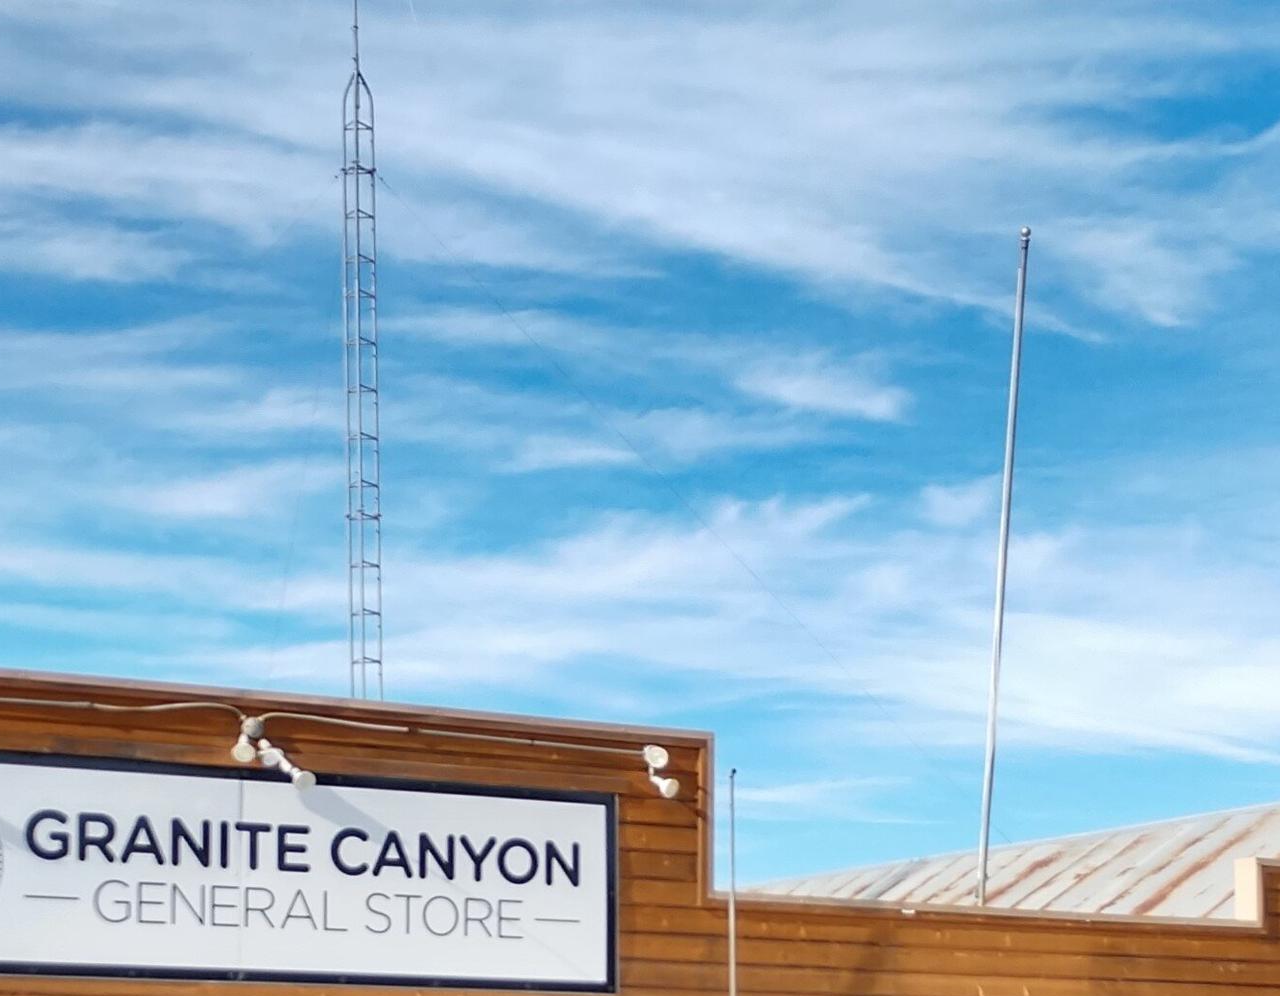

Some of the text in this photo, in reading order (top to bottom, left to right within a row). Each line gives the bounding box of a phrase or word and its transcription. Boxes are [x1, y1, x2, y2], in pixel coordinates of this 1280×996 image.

[24, 808, 582, 888] GRANITE CANYON
[93, 879, 524, 940] GENERAL STORE
